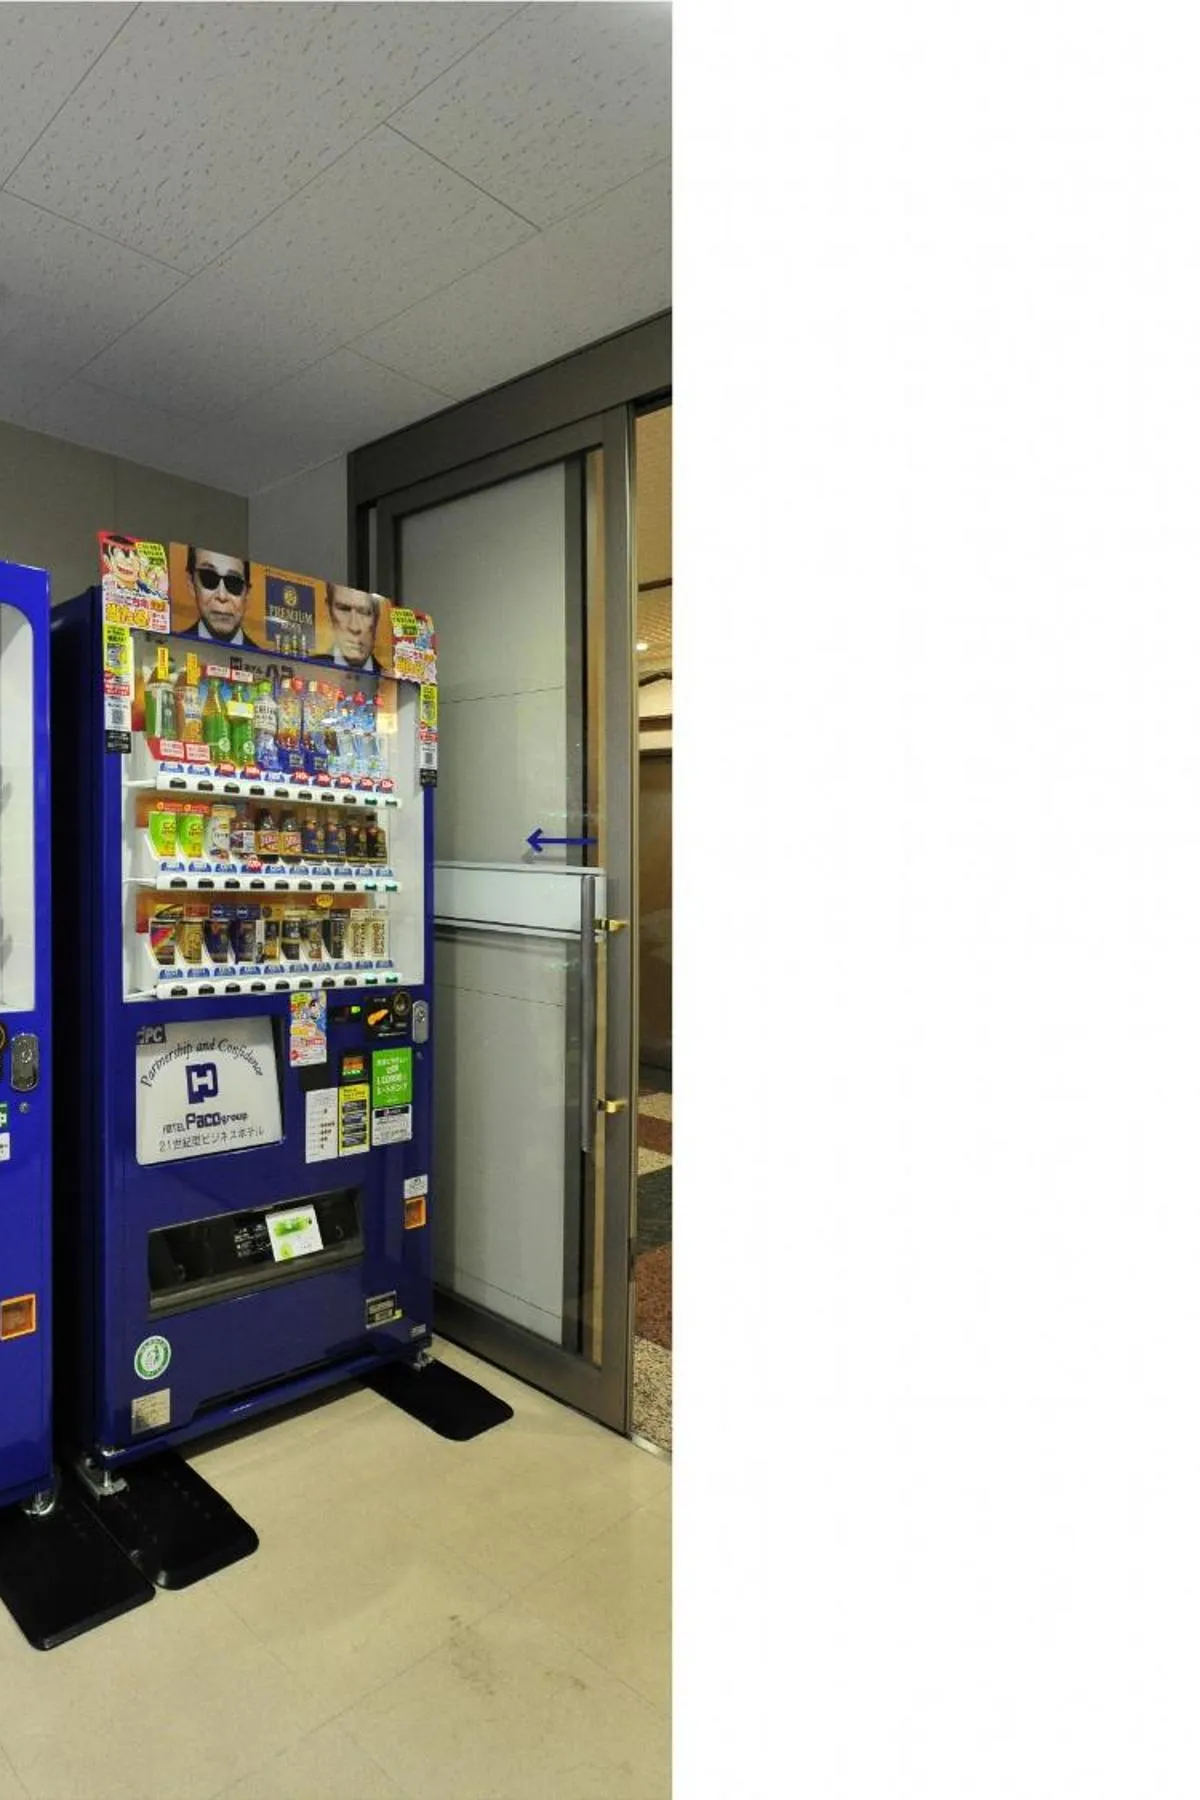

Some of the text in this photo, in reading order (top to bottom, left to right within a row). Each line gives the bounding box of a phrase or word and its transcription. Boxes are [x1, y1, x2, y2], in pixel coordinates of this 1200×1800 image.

[140, 1037, 263, 1088] Partnership and Confidence
[185, 1111, 221, 1130] Paco
